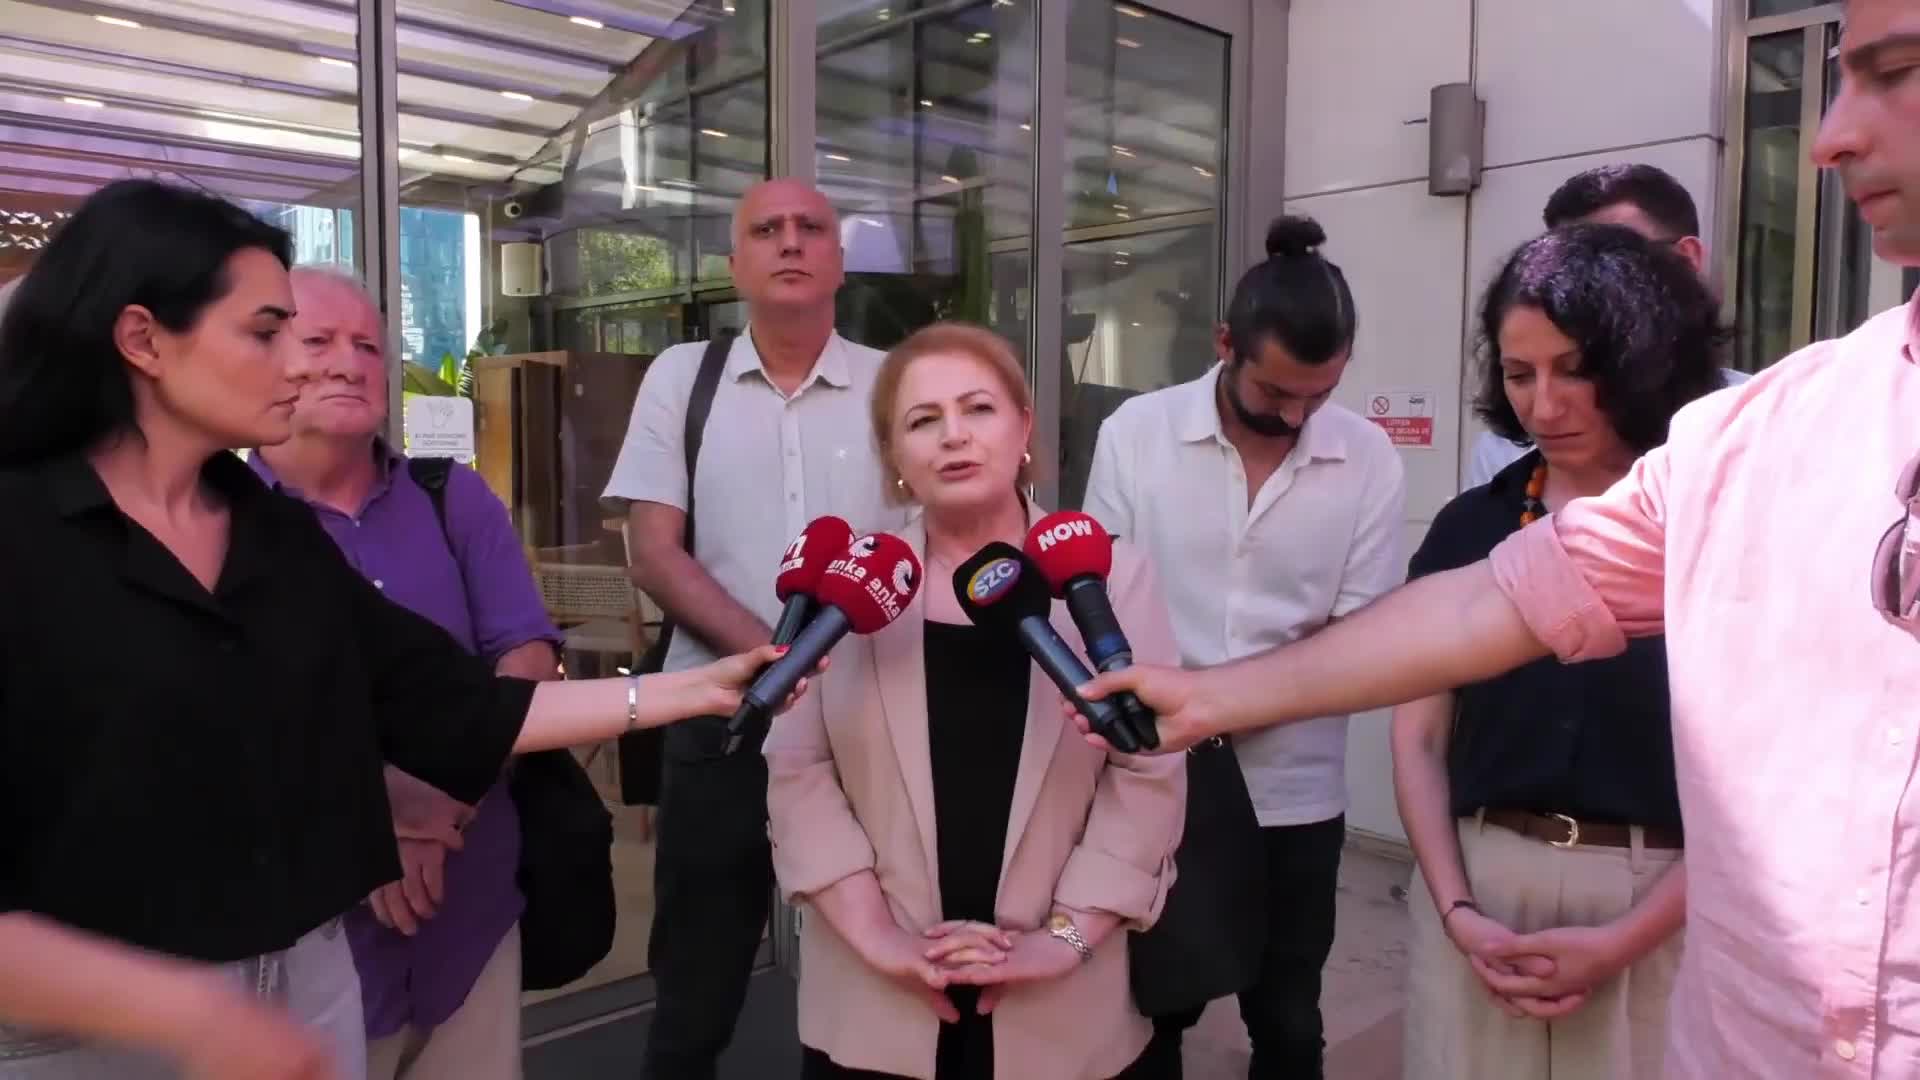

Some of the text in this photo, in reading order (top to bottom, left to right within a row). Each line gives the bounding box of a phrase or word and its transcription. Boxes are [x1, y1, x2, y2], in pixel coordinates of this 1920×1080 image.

[1037, 520, 1093, 552] NOW
[828, 557, 867, 579] anka
[974, 562, 1014, 597] SZC
[869, 577, 901, 618] anka
